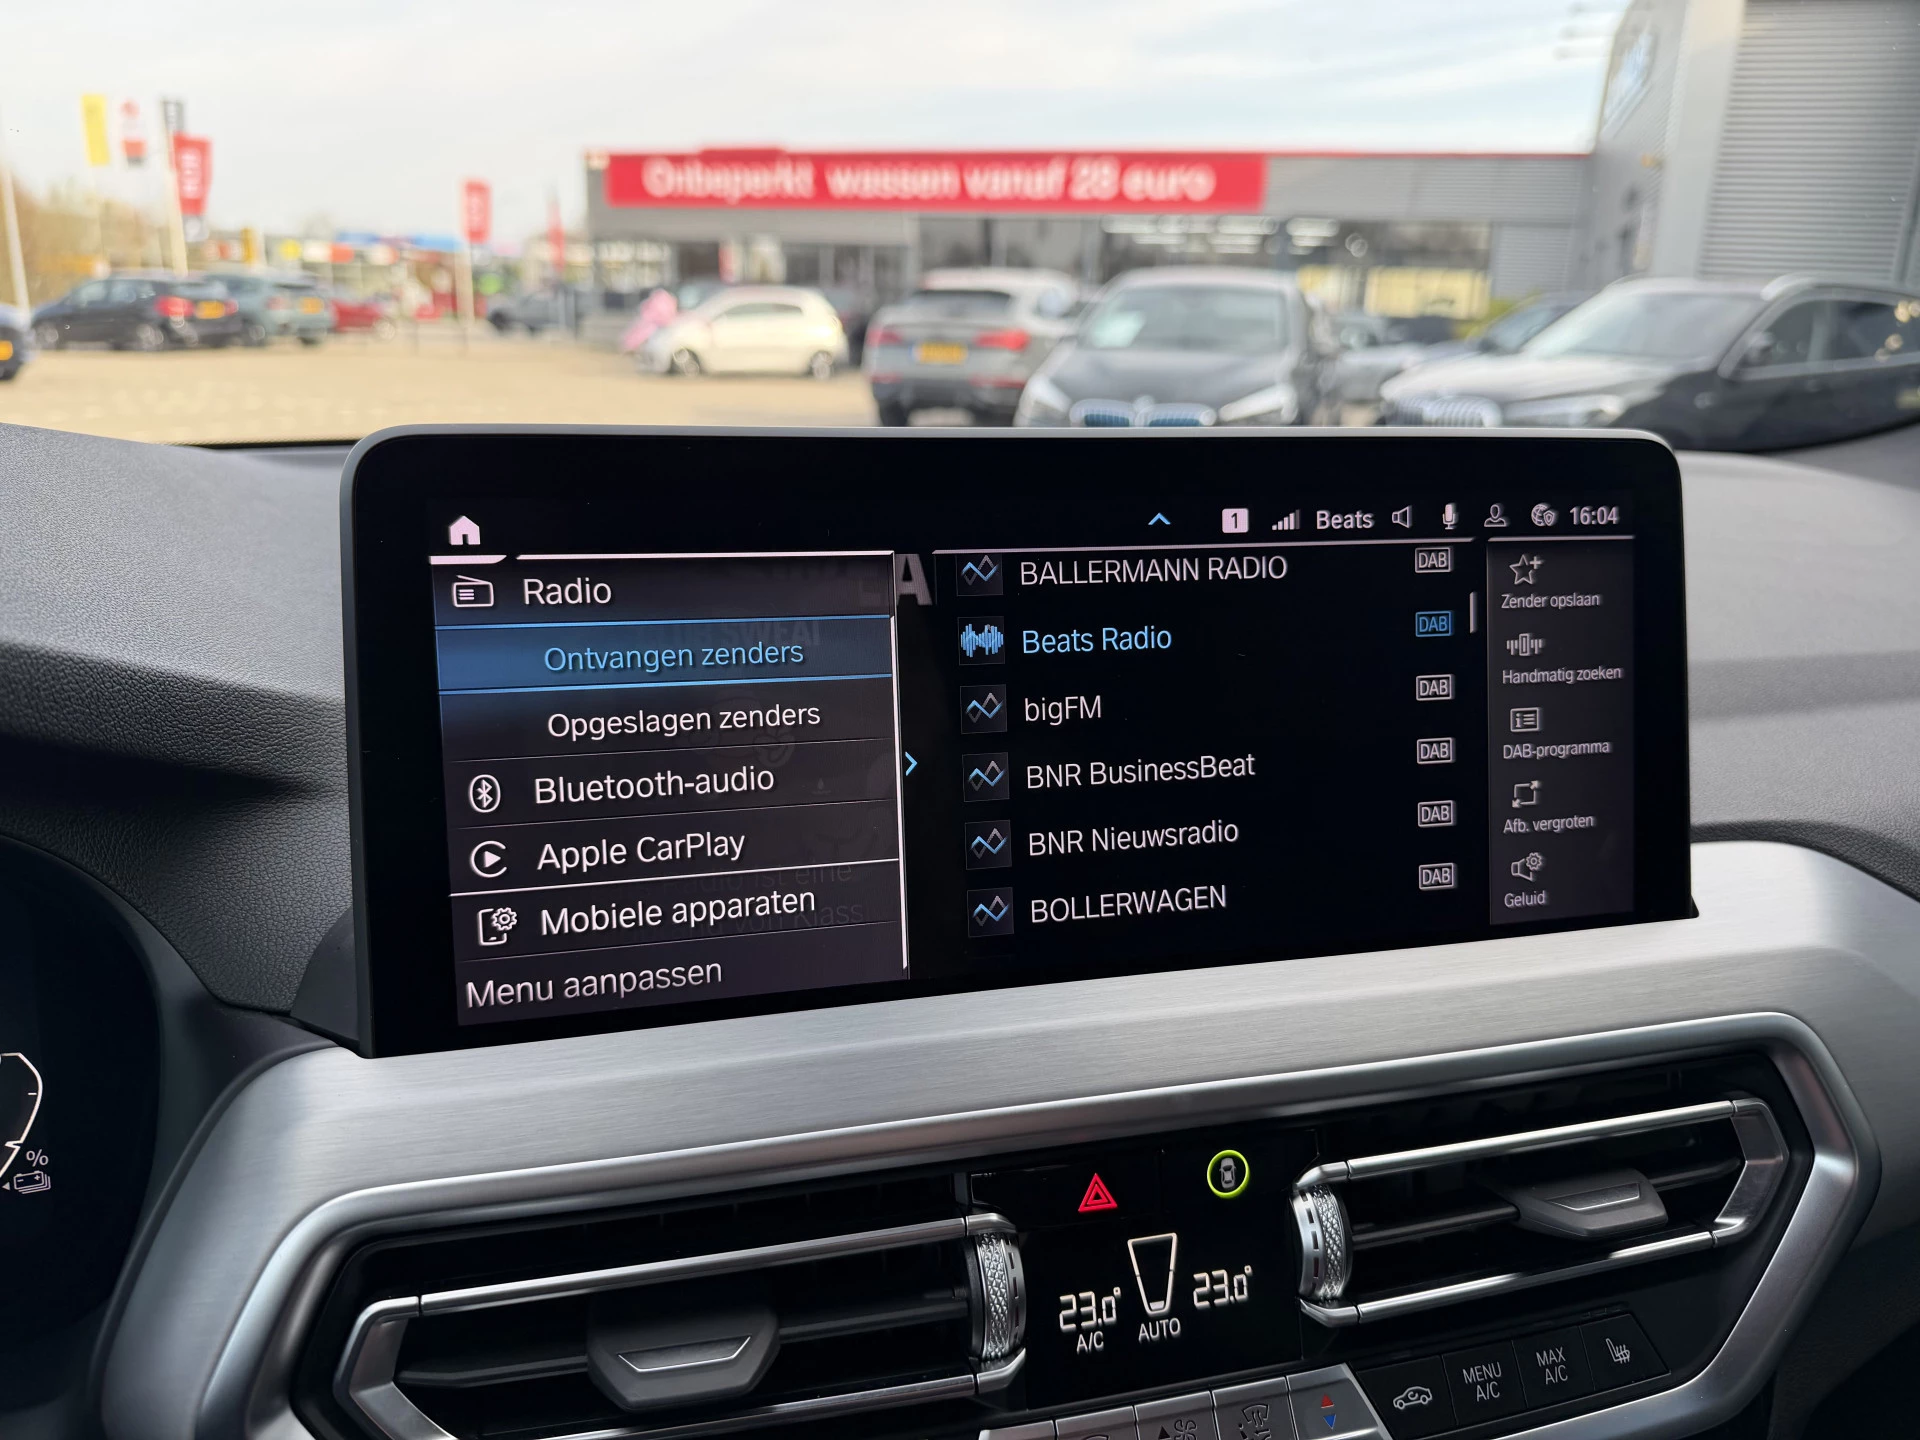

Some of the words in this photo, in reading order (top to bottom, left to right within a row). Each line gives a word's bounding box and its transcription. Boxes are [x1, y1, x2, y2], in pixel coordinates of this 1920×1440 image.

[825, 164, 960, 200] wassen
[962, 155, 1068, 200] vanaf
[1122, 163, 1217, 201] euro
[1316, 510, 1373, 530] Beats
[1569, 506, 1618, 525] 16:04
[1020, 557, 1199, 586] BALLERMANN
[1208, 555, 1287, 580] RADIO
[1418, 551, 1447, 568] DAB
[523, 577, 612, 605] Radio
[1501, 593, 1547, 609] Zender
[1550, 592, 1600, 610] opslaan
[1419, 615, 1448, 633] DAB
[1022, 629, 1094, 654] Beats
[1102, 625, 1172, 651] Radio
[543, 647, 693, 673] Ontvangen
[701, 641, 804, 666] zenders
[1502, 667, 1574, 684] Handmatig
[1576, 665, 1622, 681] zoeken
[1419, 679, 1448, 696] DAB
[1024, 695, 1101, 726] bigFM
[547, 709, 711, 742] Opgeslagen
[719, 703, 821, 729] zenders
[1421, 743, 1450, 761] DAB
[1503, 741, 1610, 760] DAB-programma
[1027, 763, 1082, 789] BNR
[1090, 753, 1256, 785] BusinessBeat
[535, 765, 774, 804] Bluetooth-audio
[1422, 806, 1451, 824] DAB
[1503, 818, 1529, 834] Afb.
[1532, 815, 1594, 833] vergroten
[1029, 829, 1084, 856] BNR
[1092, 819, 1239, 852] Nieuwsradio
[537, 838, 627, 875] Apple
[636, 831, 745, 863] CarPlay
[1423, 868, 1452, 887] DAB
[1031, 884, 1226, 923] BOLLERWAGEN
[1504, 890, 1546, 908] Geluid
[541, 900, 663, 936] Mobiele
[672, 890, 815, 928] apparaten
[466, 979, 553, 1008] Menu
[564, 962, 722, 998] aanpassen
[1138, 1317, 1181, 1341] AUTO
[1076, 1331, 1104, 1354] A/C
[1536, 1347, 1566, 1367] MAX
[1462, 1361, 1502, 1385] MENU
[1544, 1365, 1568, 1385] A/C
[1476, 1381, 1500, 1402] A/C
